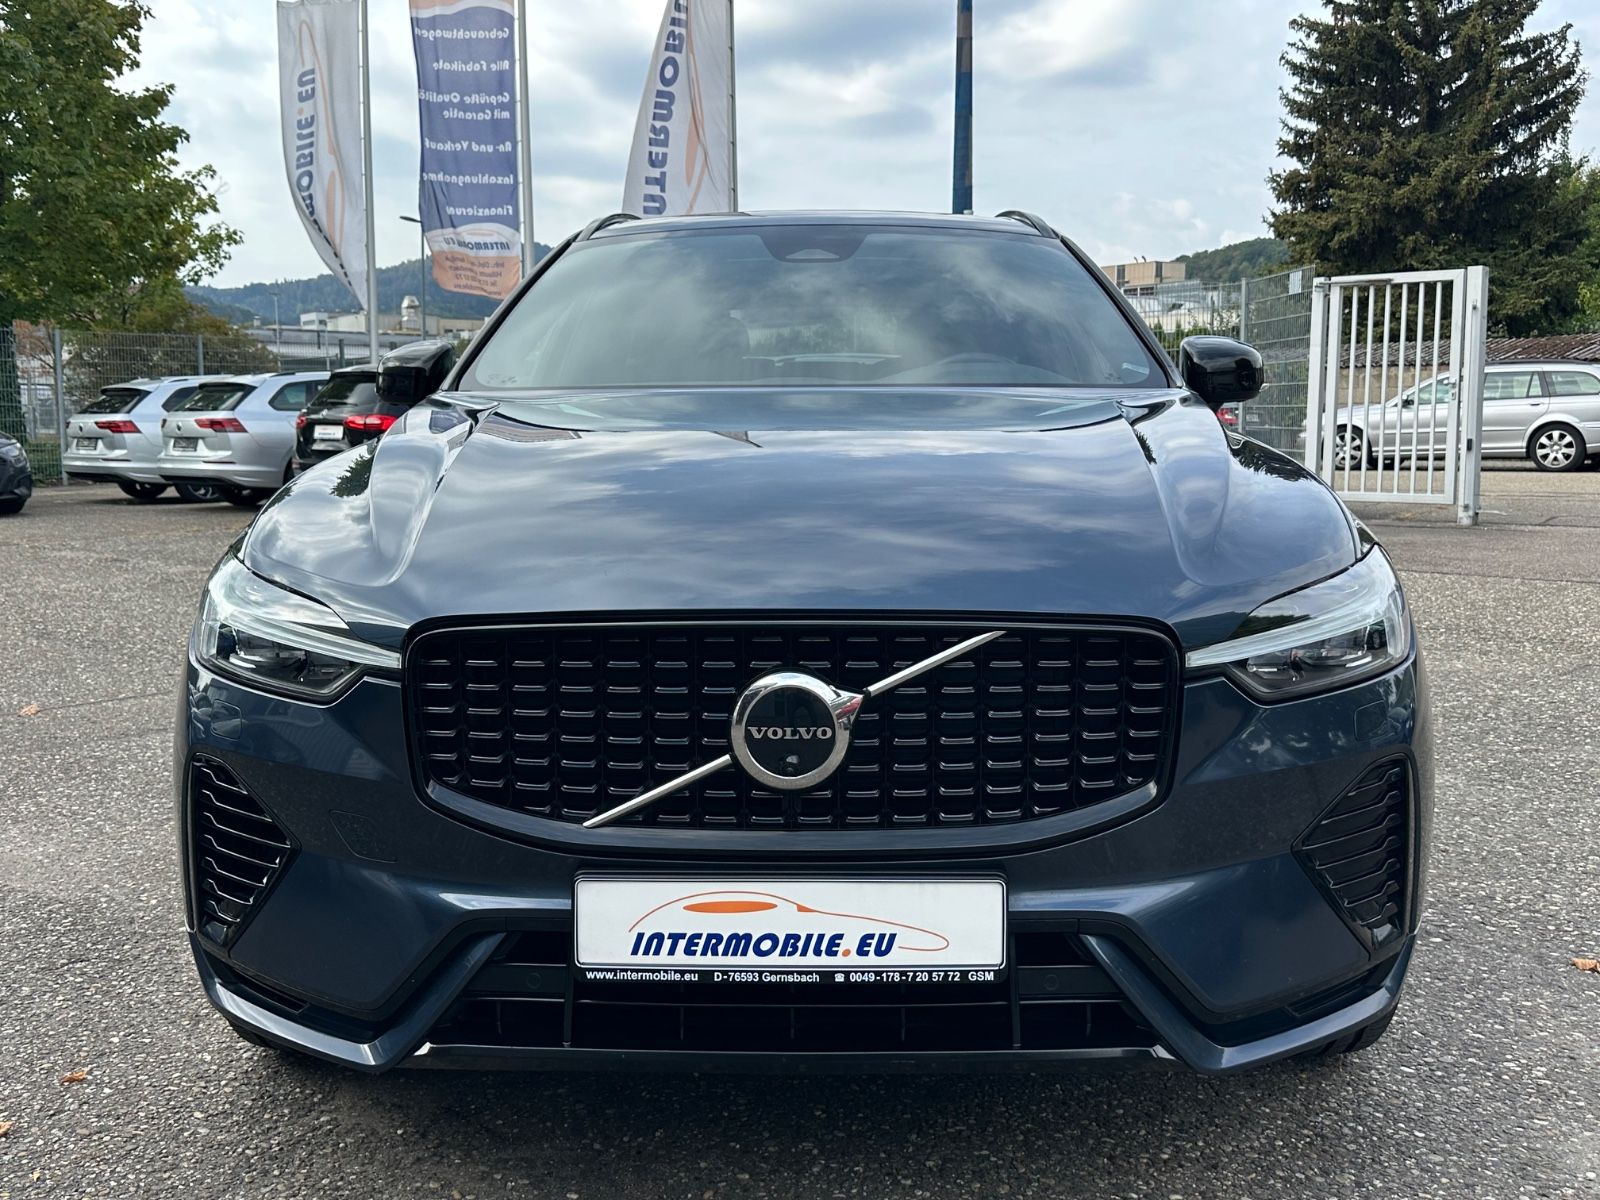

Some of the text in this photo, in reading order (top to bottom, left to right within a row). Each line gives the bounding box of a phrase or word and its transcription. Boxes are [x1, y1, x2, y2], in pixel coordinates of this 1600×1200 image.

[747, 726, 833, 740] VOLVO
[630, 931, 898, 958] INTERMOBILE.EU
[585, 970, 699, 982] www.intermobile.eu
[714, 971, 760, 983] D-76593
[761, 971, 820, 983] Gernsbach
[915, 971, 929, 982] 20
[931, 971, 945, 982] 57
[948, 971, 961, 982] 72
[967, 970, 995, 982] GSM
